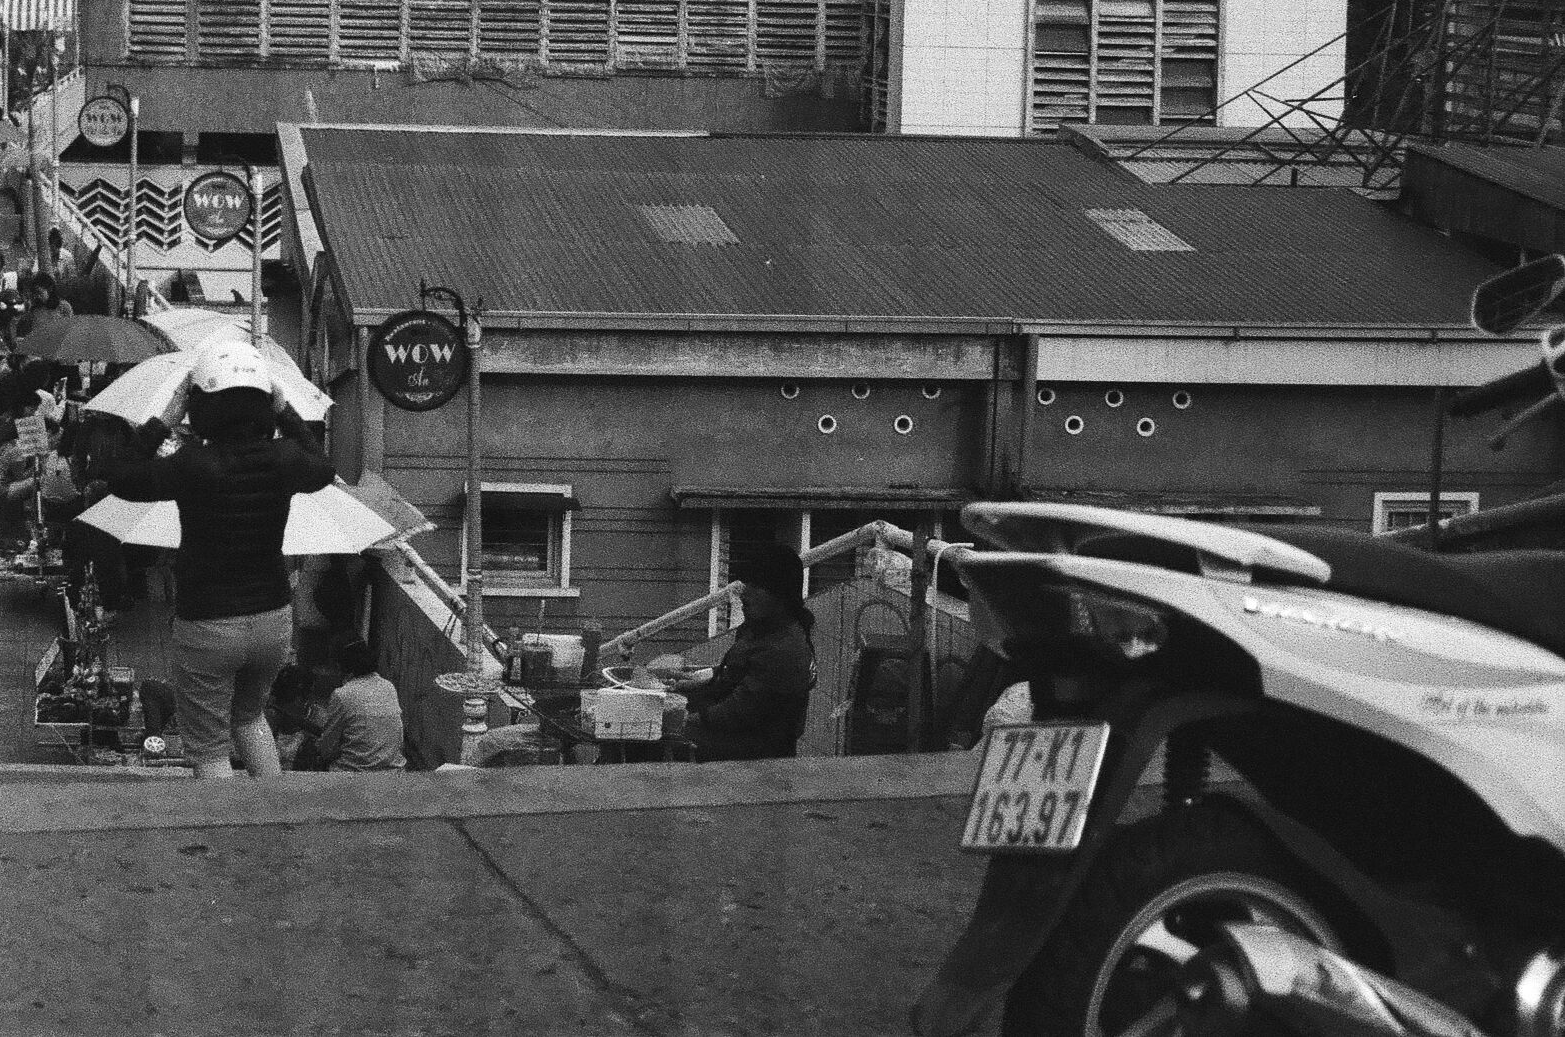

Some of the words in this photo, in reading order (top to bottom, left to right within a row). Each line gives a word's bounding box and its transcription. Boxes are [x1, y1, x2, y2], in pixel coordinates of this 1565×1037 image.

[193, 193, 245, 209] WOW
[384, 343, 457, 364] WOW
[972, 791, 1081, 844] 163.97
